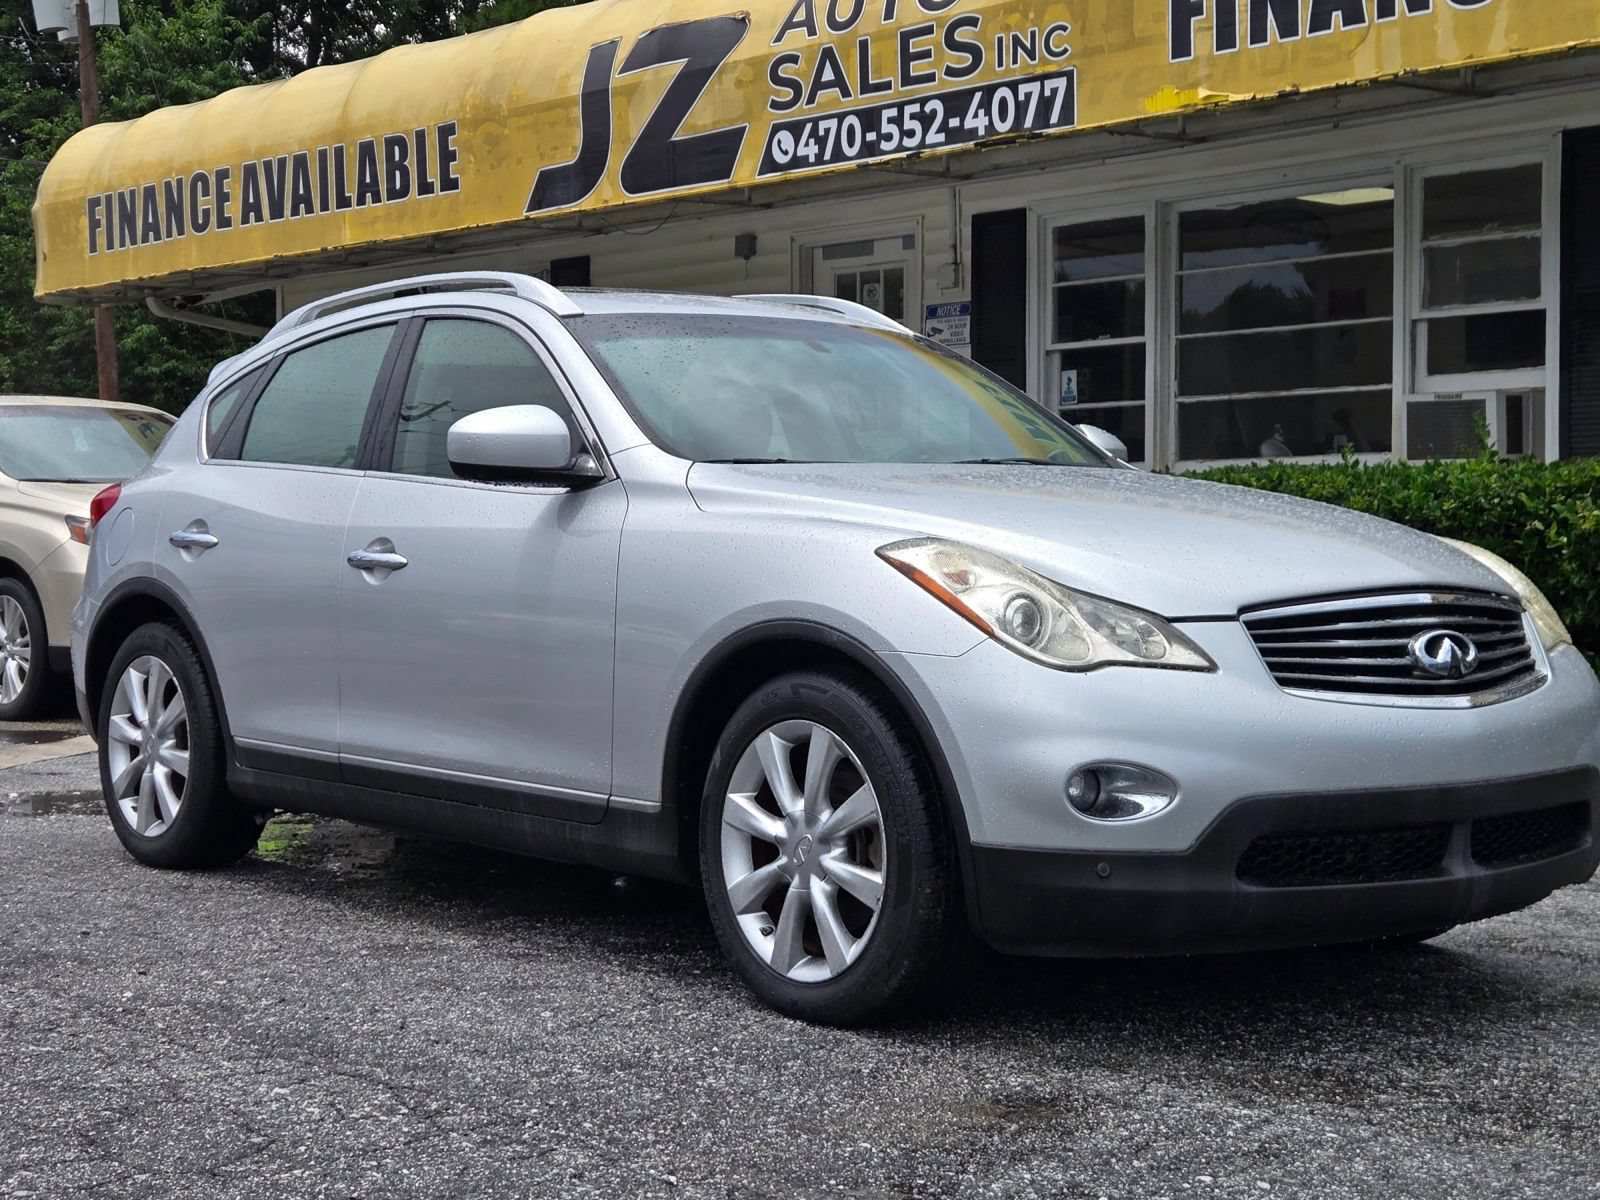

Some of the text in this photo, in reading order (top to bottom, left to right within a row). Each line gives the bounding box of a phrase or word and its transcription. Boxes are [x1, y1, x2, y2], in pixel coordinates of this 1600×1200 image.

[767, 13, 1072, 114] SALES INC
[769, 0, 962, 47] AU
[523, 12, 751, 217] JZ
[796, 75, 1070, 164] 470-552-4077
[87, 119, 462, 256] FINANCE AVAILABLE
[936, 304, 961, 317] NOTICE
